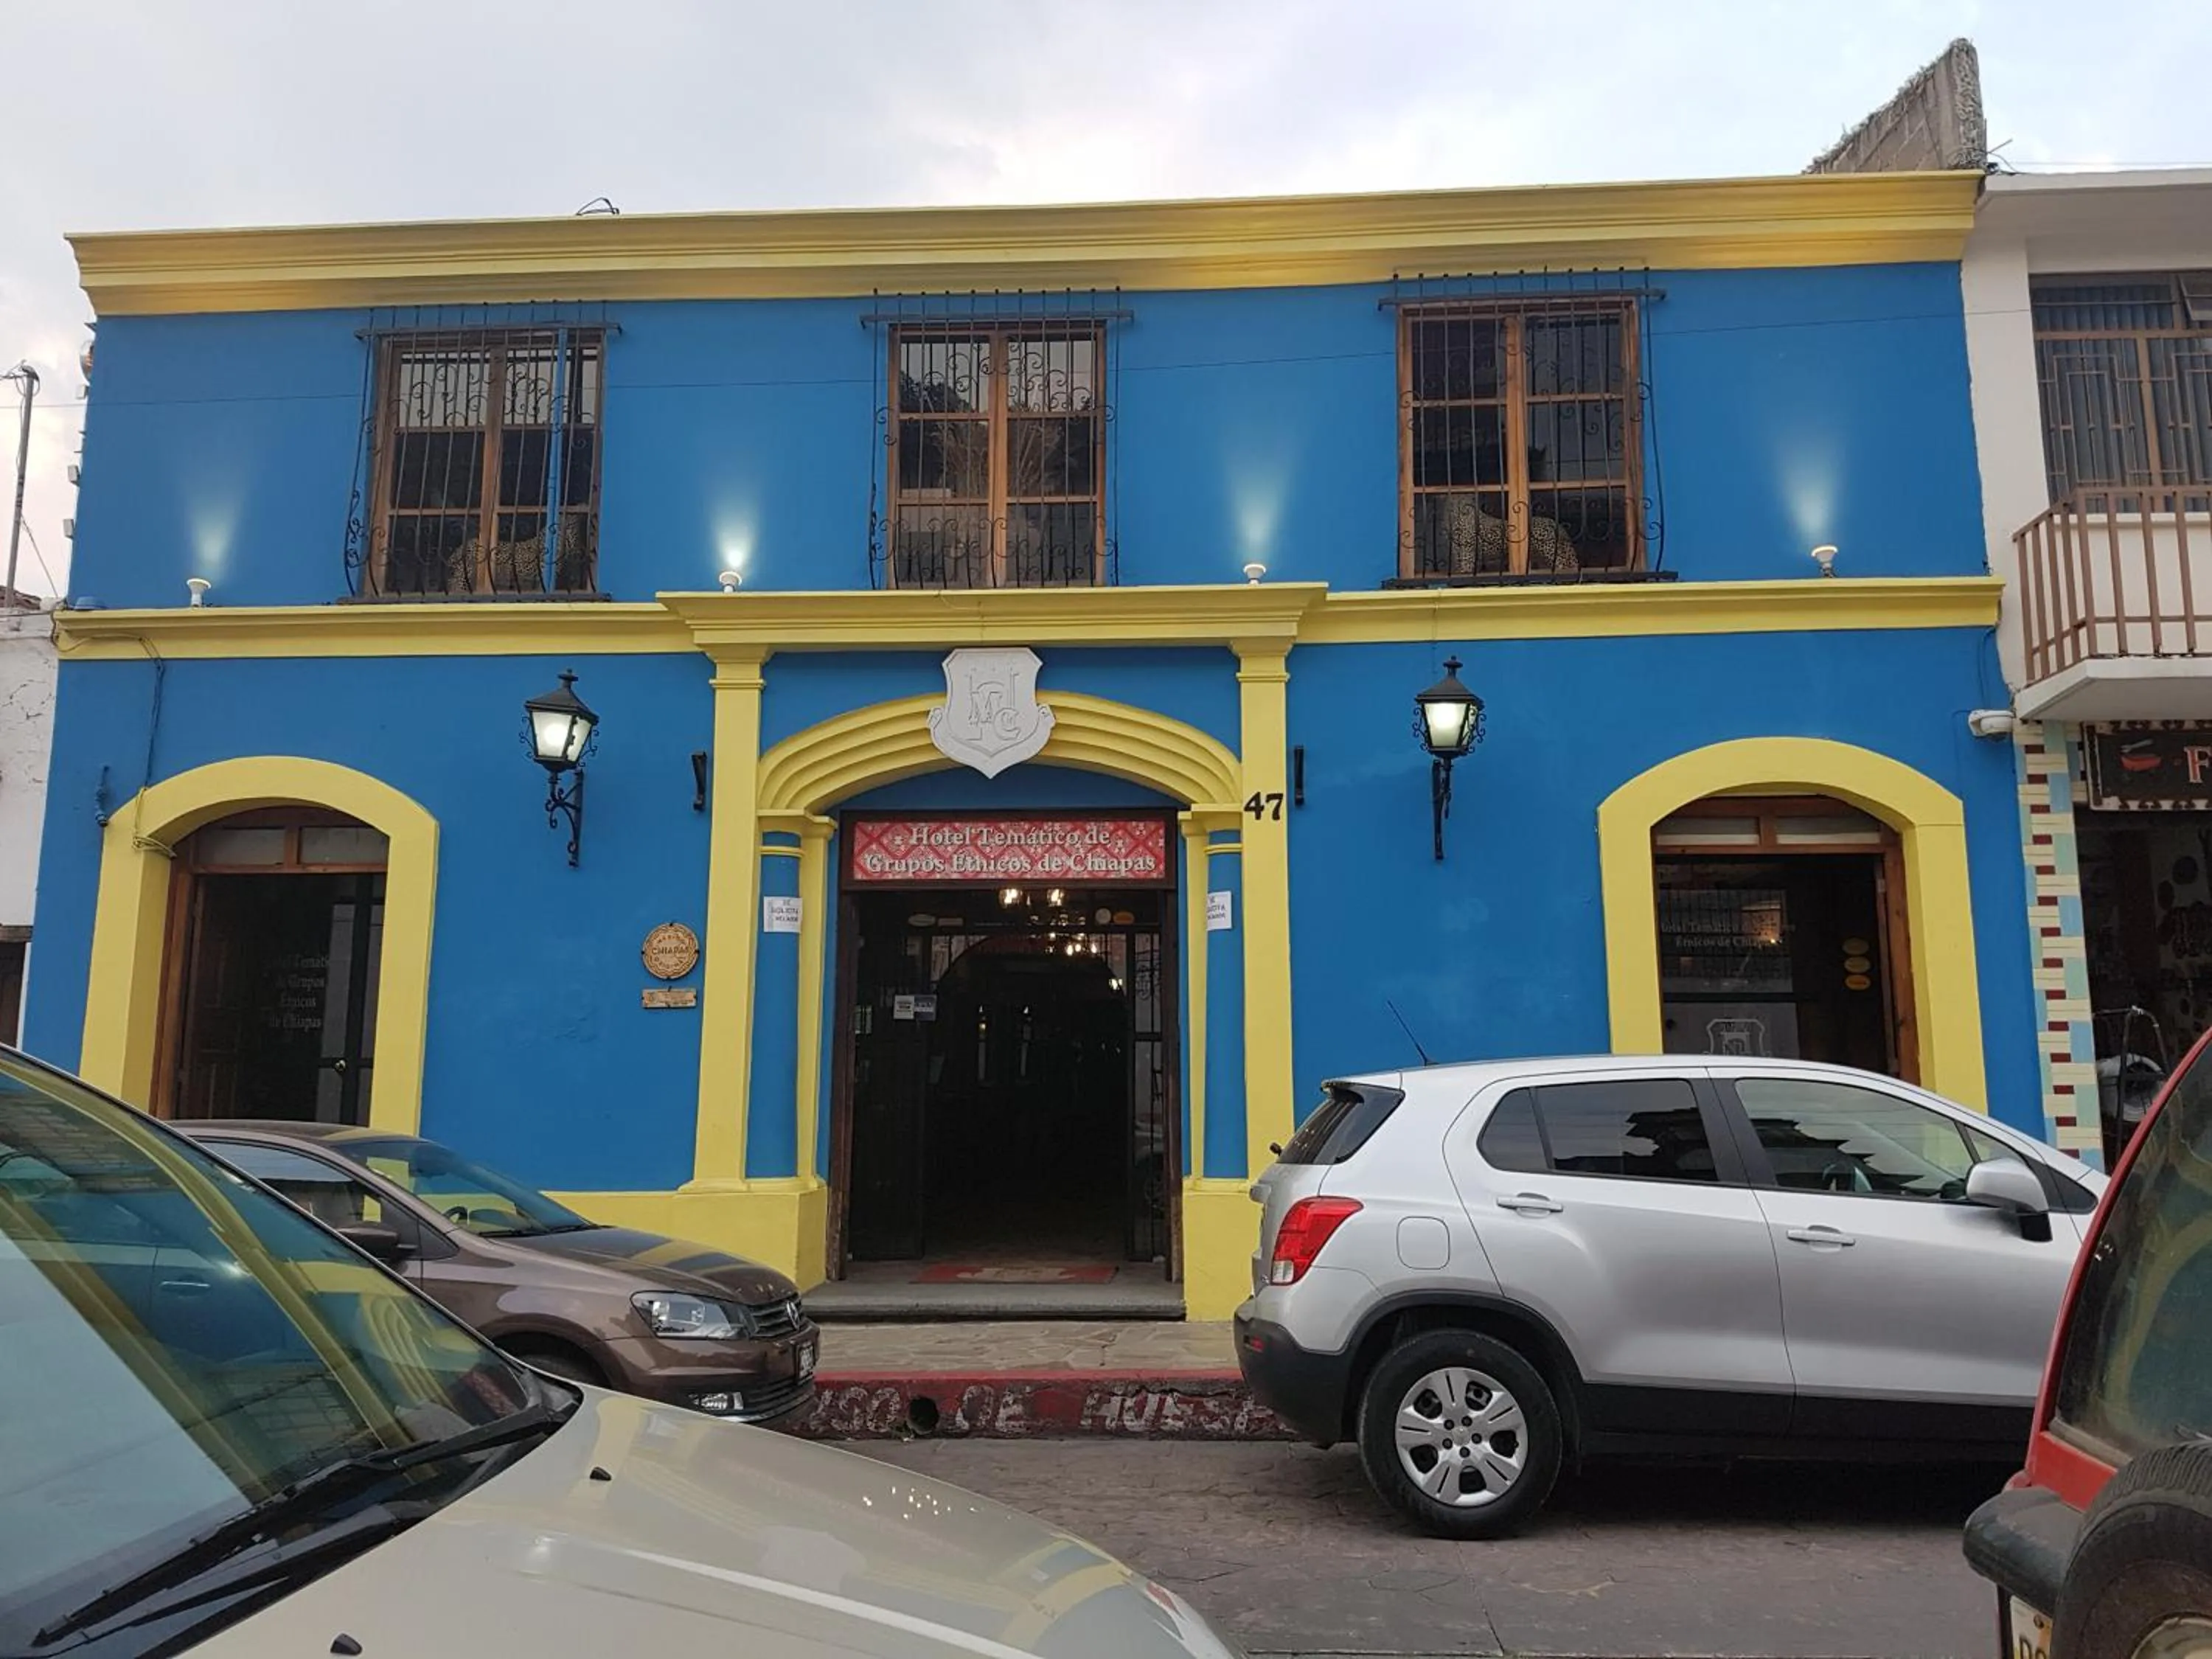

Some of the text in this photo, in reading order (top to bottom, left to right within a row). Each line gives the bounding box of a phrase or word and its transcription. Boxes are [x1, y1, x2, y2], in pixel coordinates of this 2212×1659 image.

[1244, 792, 1284, 821] 47
[910, 824, 1109, 846] Hotel Temático de
[865, 850, 1155, 876] Grupos Étnicos de Chiapas
